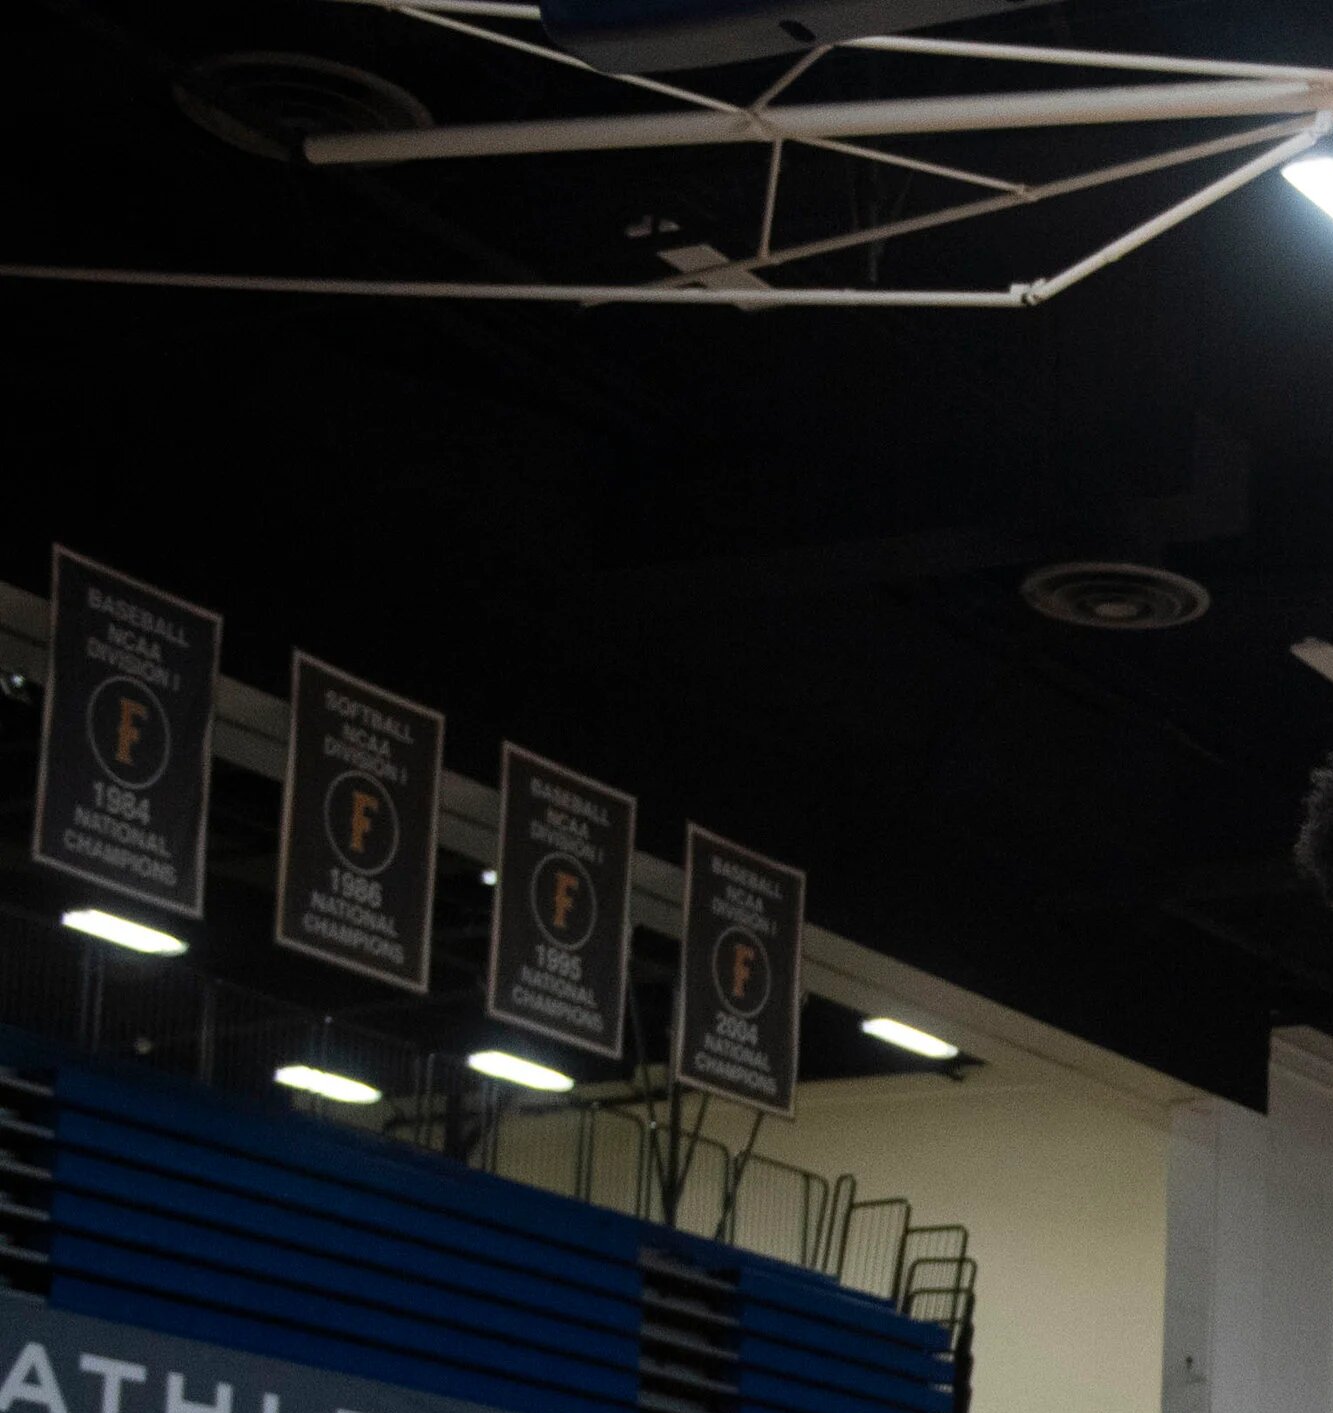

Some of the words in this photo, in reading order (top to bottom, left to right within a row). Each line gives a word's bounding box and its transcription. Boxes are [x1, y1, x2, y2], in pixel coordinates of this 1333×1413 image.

[64, 828, 178, 886] CHAMPIONS
[73, 803, 171, 859] NATIONAL
[303, 912, 404, 965] CHAMPIONS
[309, 890, 398, 938] NATIONAL
